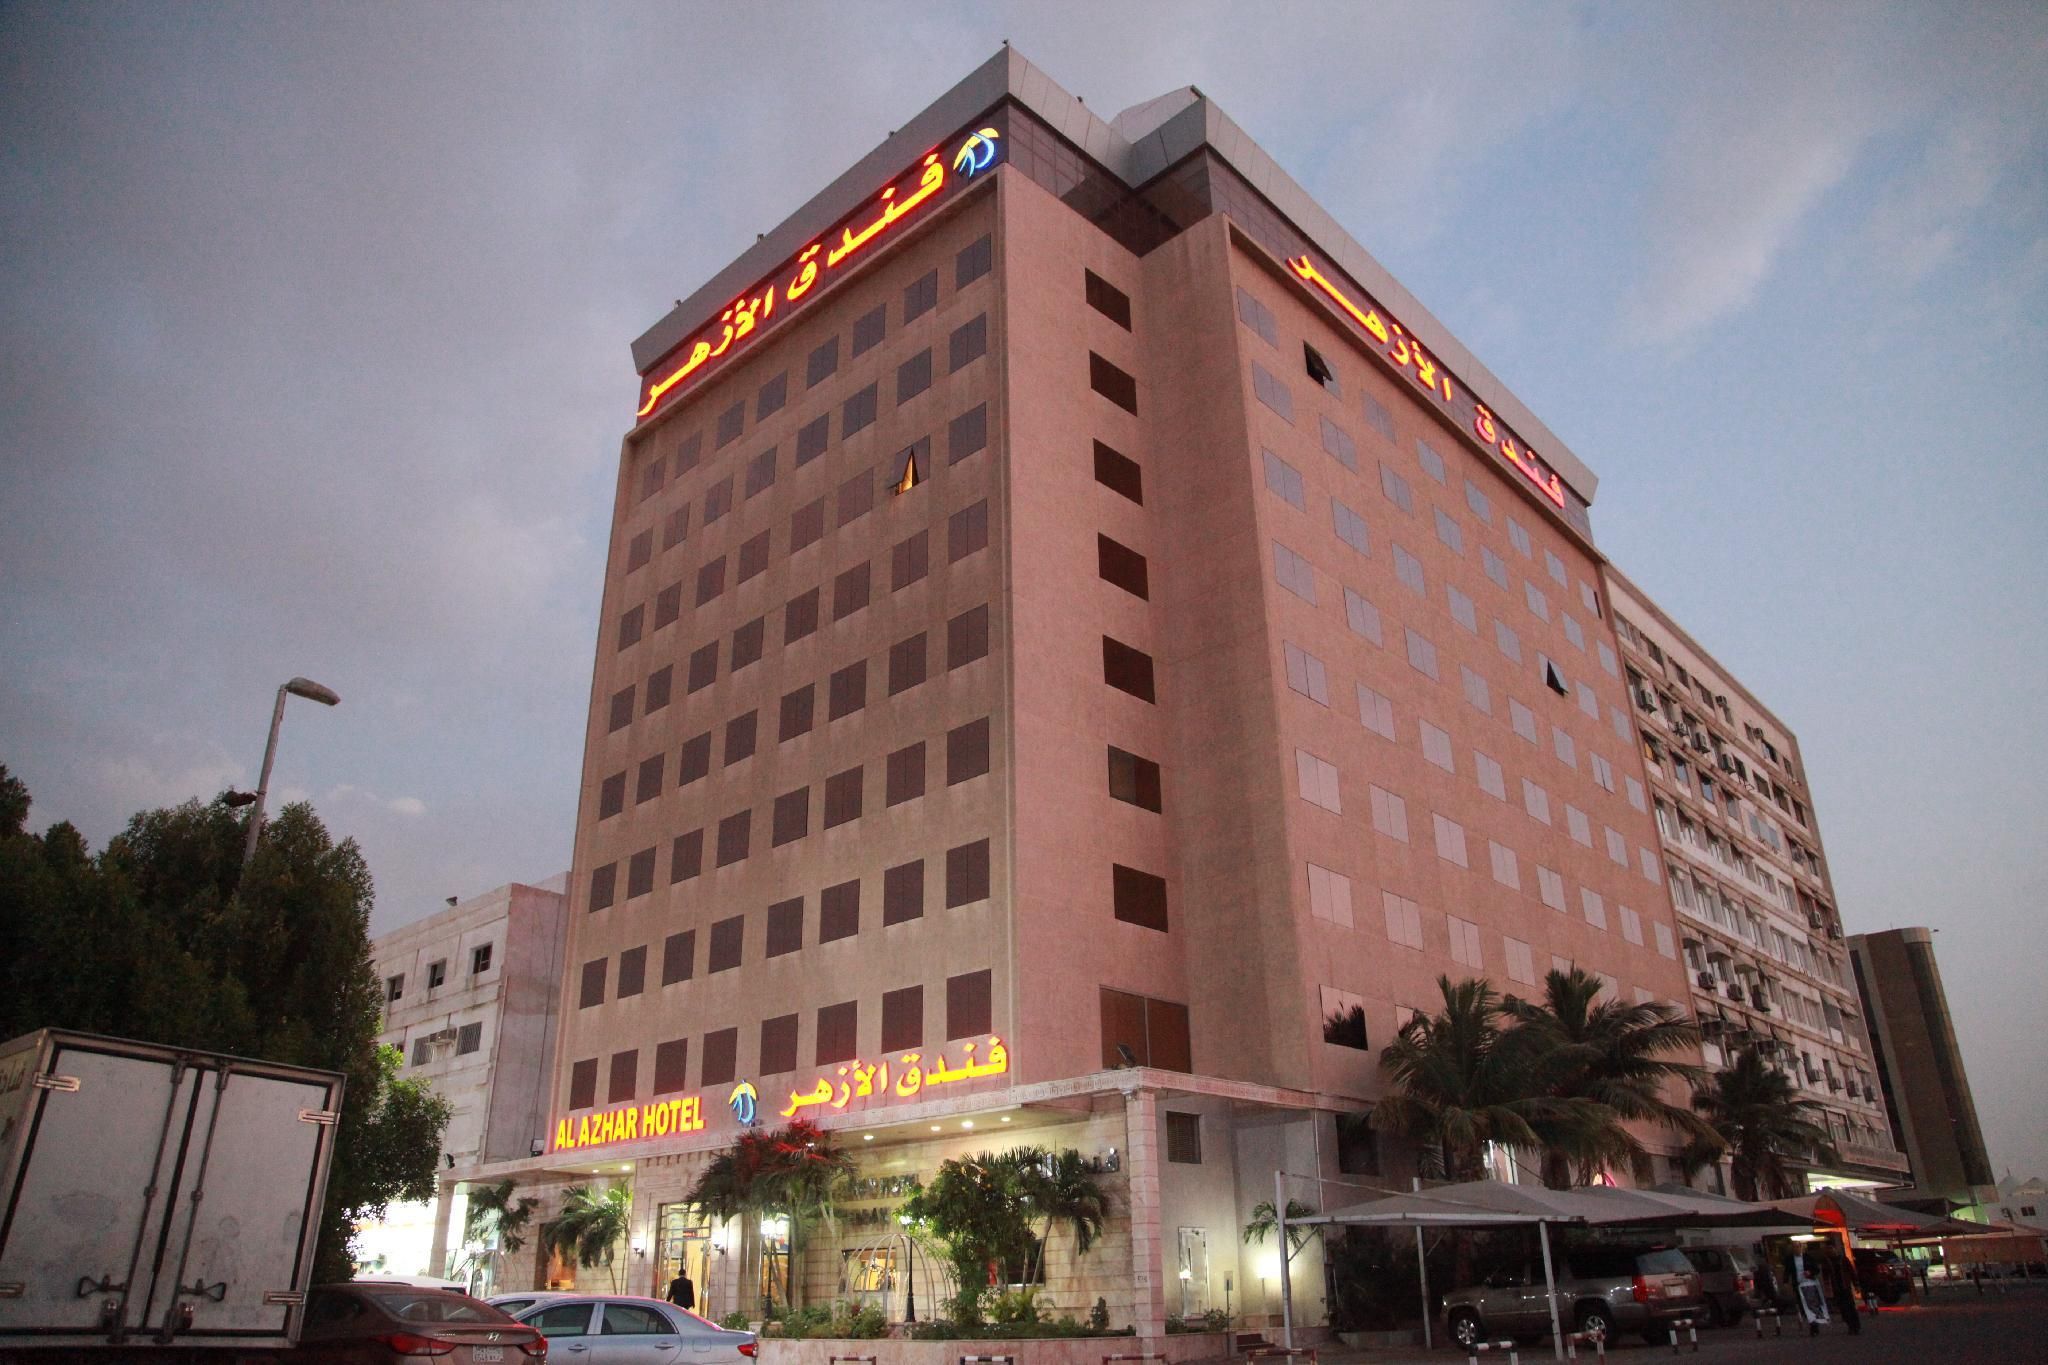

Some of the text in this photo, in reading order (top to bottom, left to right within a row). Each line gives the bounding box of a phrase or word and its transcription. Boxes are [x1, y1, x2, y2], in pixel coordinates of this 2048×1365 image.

[787, 152, 944, 301] فندق
[1475, 404, 1565, 508] فندق
[895, 1036, 1008, 1097] فندق
[554, 1096, 705, 1151] AL AZHAR HOTEL
